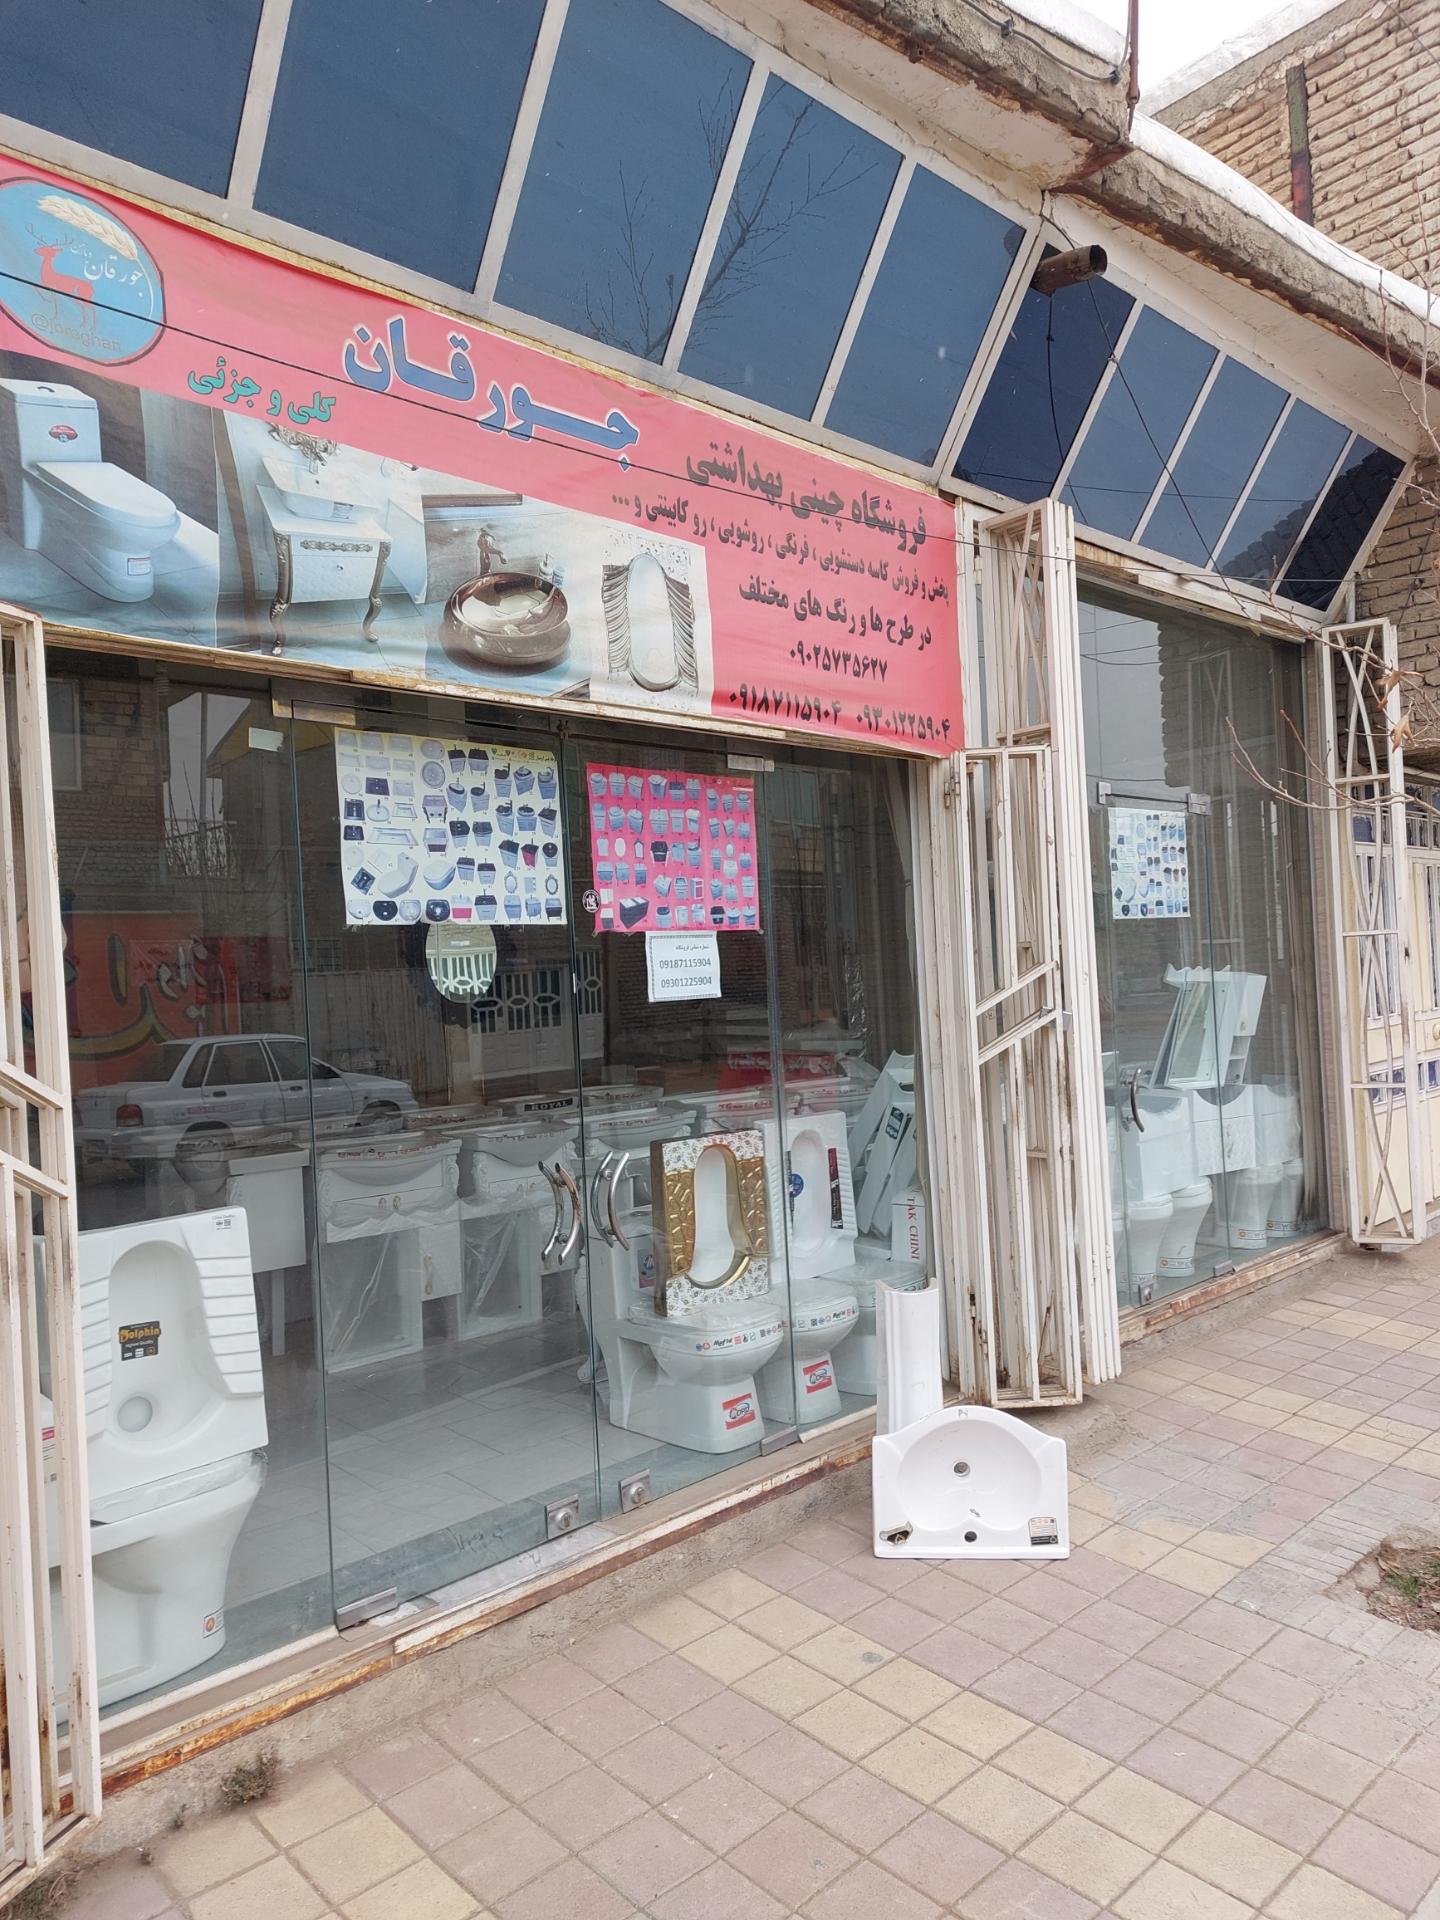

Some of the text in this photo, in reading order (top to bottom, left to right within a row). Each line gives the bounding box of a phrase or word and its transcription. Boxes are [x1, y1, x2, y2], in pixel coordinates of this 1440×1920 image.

[188, 356, 337, 424] کلی و جزئی
[343, 314, 639, 471] جورقان
[634, 495, 642, 517] و
[646, 494, 689, 528] کابینتی
[686, 441, 927, 555] فروشگاه چینی بهداشتی
[718, 519, 765, 554] روشویی
[775, 532, 809, 565] فرنگی
[820, 549, 865, 574] دستشویی
[867, 560, 889, 581] کاسه
[892, 565, 919, 596] فروش
[920, 581, 926, 599] و
[928, 576, 949, 606] پخش
[738, 575, 932, 651] در طرح ها و رنگ های مختلف
[789, 639, 888, 683] ۰۹۰۲۵۷۳۵۶۲۷
[729, 682, 842, 726] ۰۹۱۸۷۱۱۵۹۰۴
[660, 958, 712, 969] 09187115904
[661, 976, 712, 988] 09301225904
[531, 1100, 569, 1110] ROYAL
